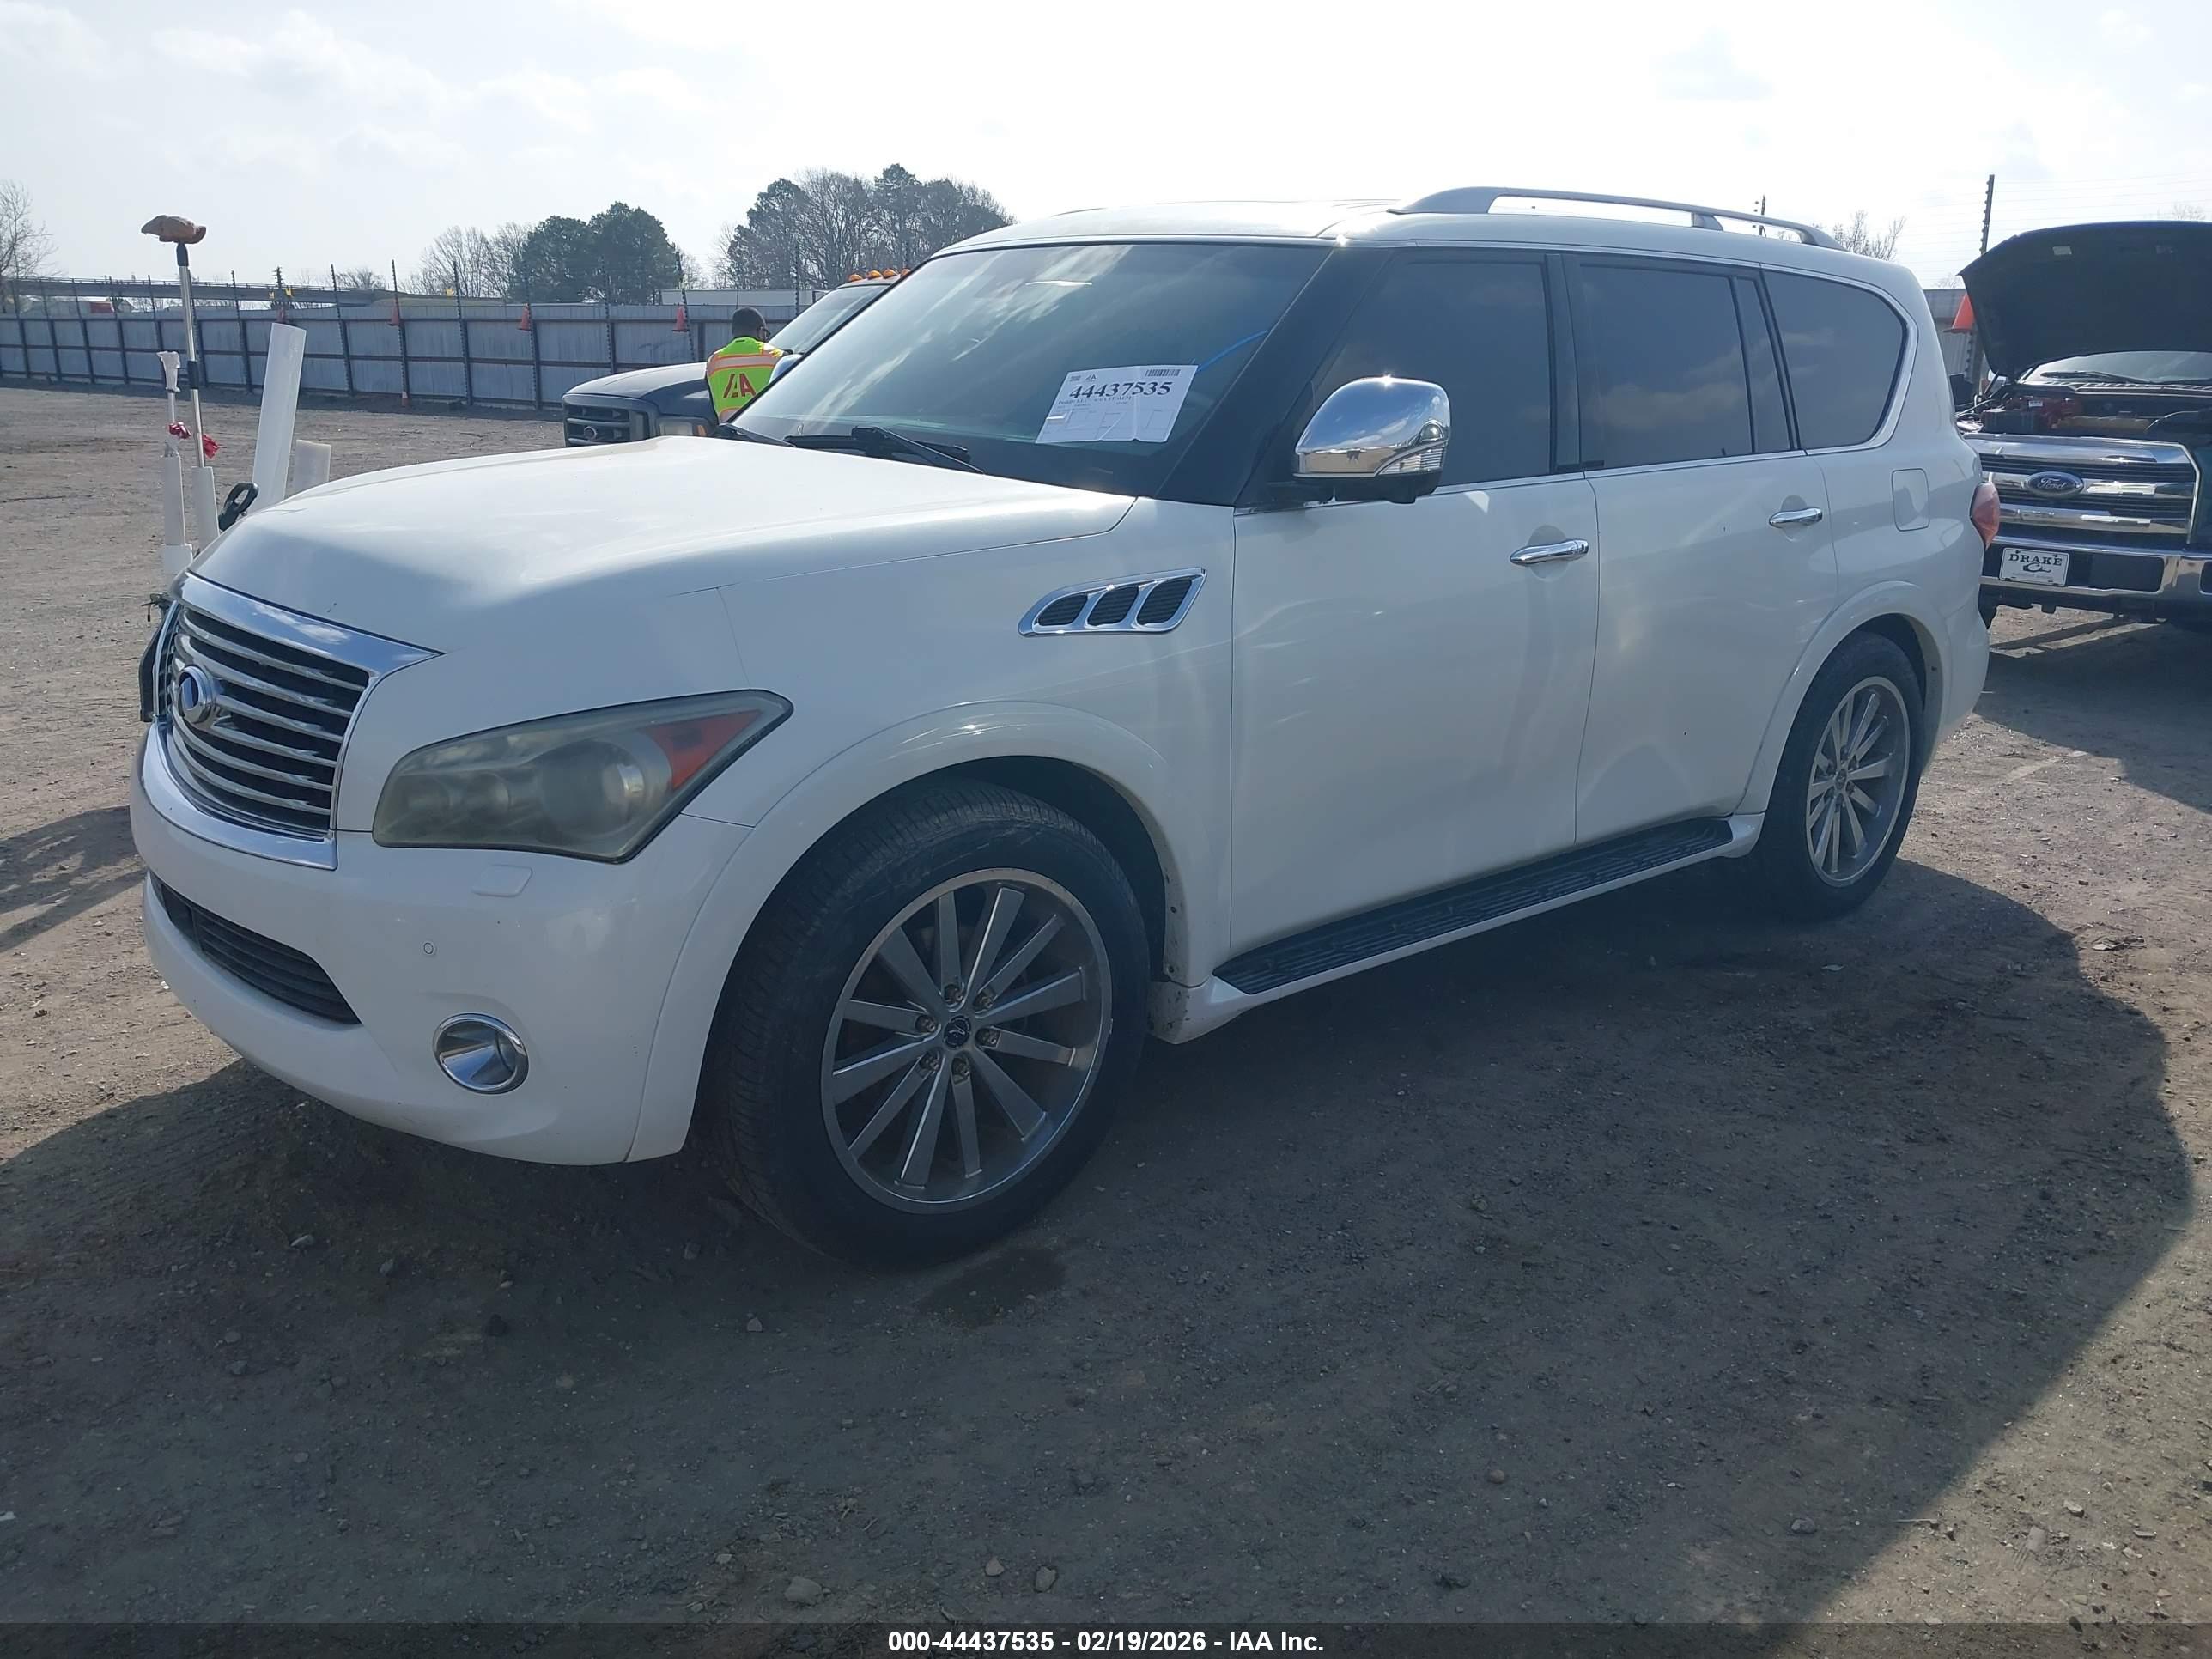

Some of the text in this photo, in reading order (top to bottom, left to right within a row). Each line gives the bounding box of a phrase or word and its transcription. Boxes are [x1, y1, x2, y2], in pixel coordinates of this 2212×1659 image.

[1069, 381, 1173, 399] 44437535
[2037, 477, 2068, 490] Ford
[2008, 554, 2063, 566] DRAKE
